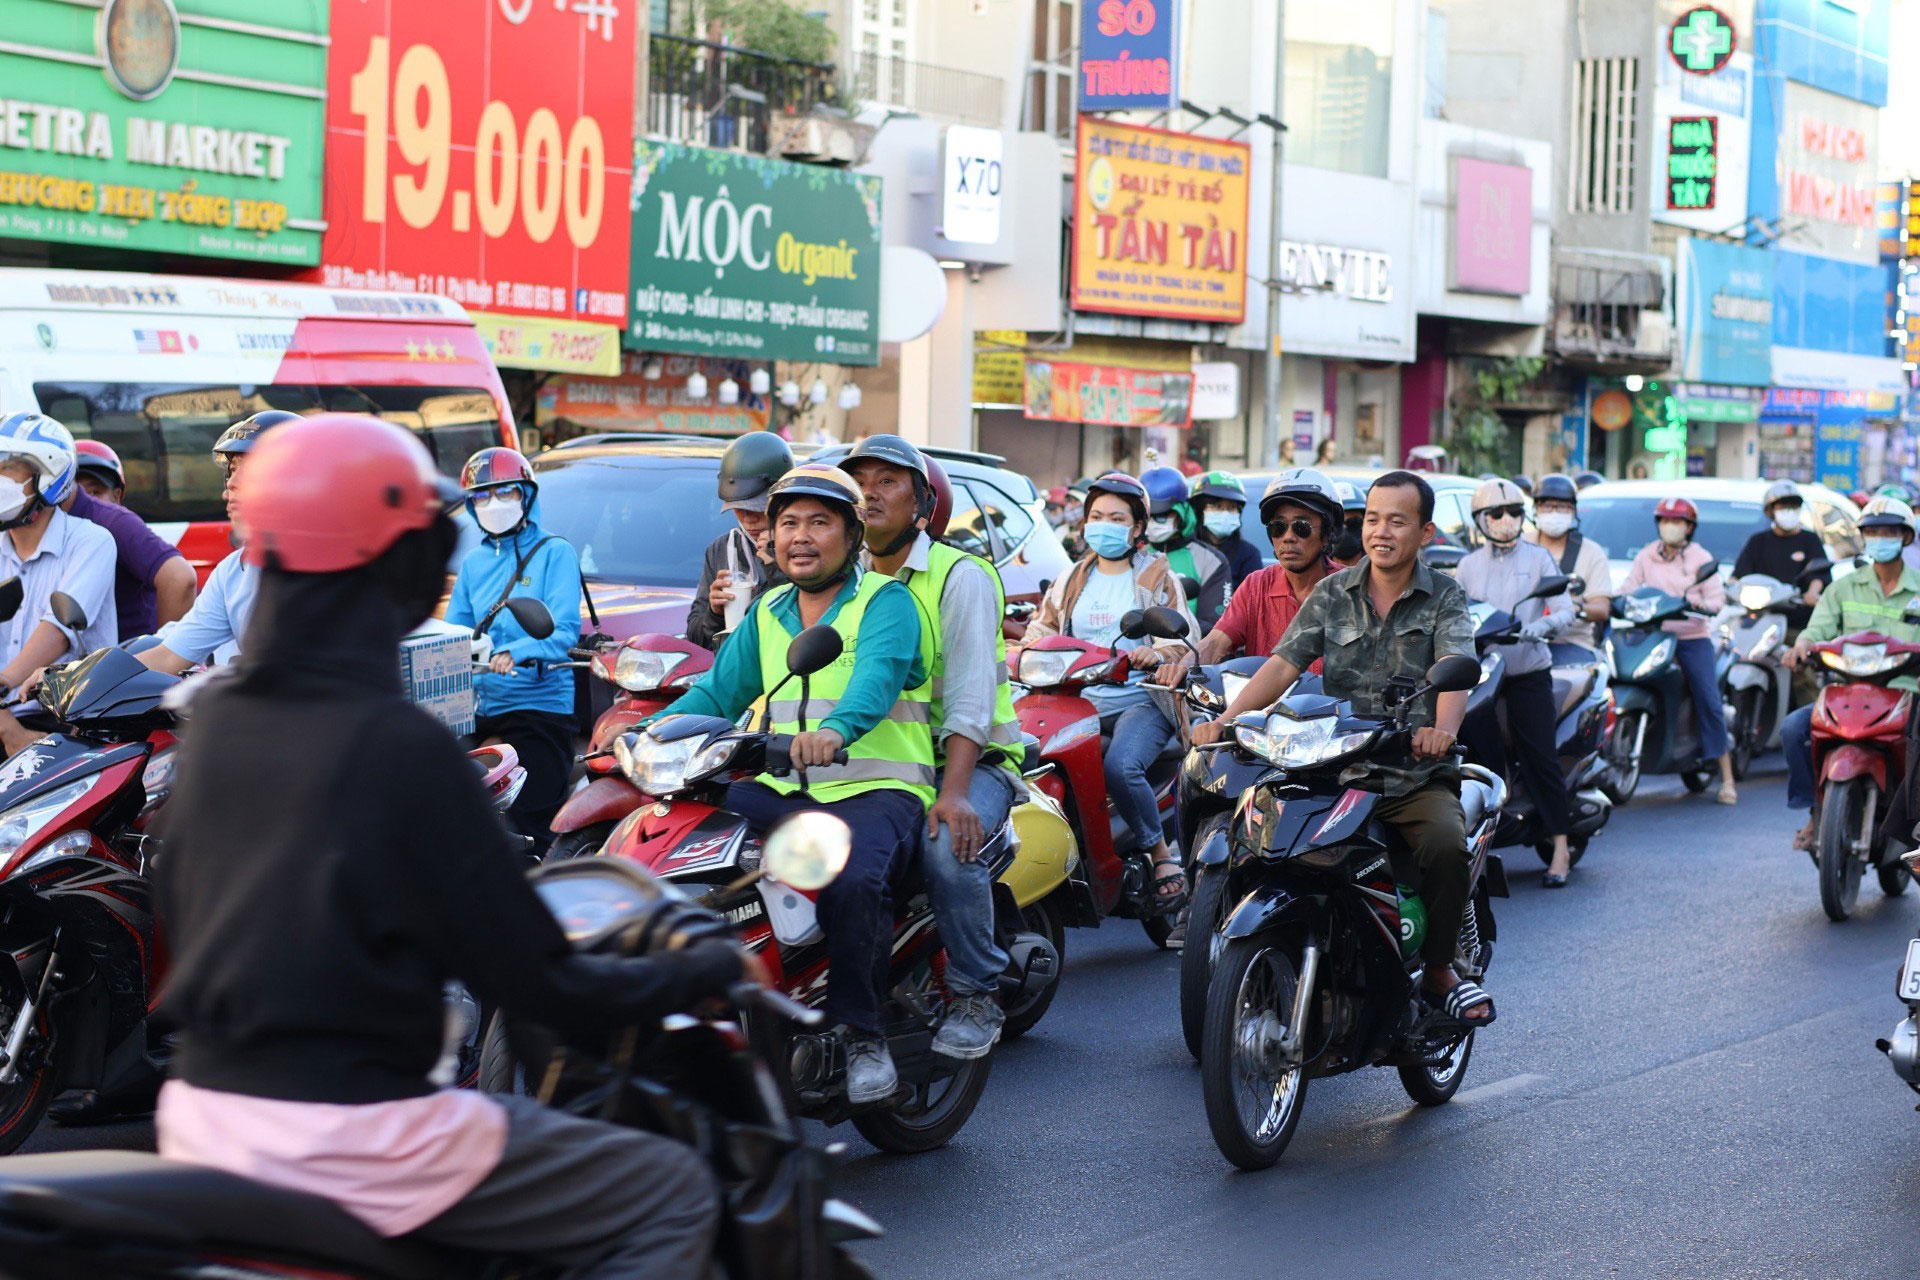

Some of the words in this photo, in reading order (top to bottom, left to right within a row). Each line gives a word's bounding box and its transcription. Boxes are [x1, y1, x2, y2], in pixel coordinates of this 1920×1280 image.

[0, 99, 113, 159] ETRA
[126, 117, 290, 179] MARKET
[351, 36, 604, 248] 19.000
[956, 156, 1001, 196] X70
[655, 184, 772, 279] MỘC
[776, 232, 859, 286] Organic
[1178, 212, 1236, 273] TÀI
[1280, 240, 1392, 303] ENVIE
[1279, 783, 1310, 792] HONDA
[1355, 858, 1386, 880] HONDA
[716, 901, 763, 926] MAHA
